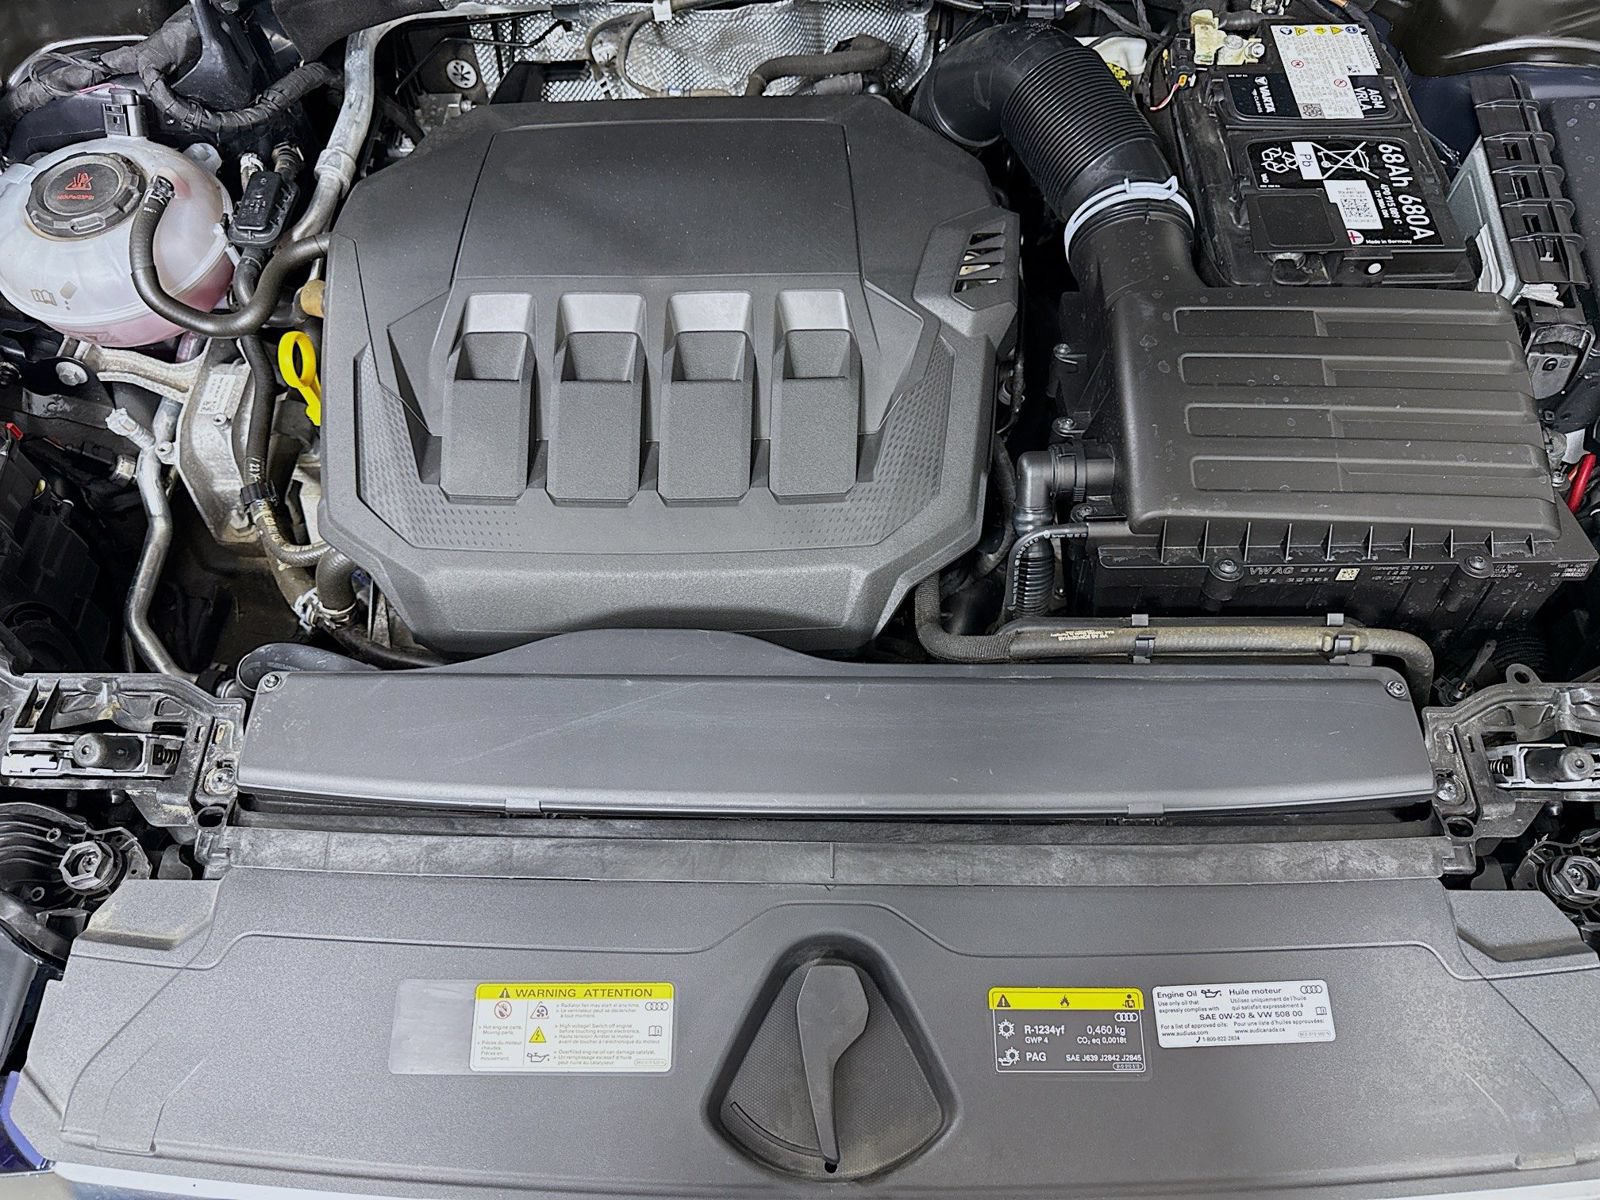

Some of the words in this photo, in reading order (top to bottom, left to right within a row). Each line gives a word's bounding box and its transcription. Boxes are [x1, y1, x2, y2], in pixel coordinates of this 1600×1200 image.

[1259, 86, 1276, 113] VARTA
[1354, 87, 1372, 110] VRLA
[1366, 88, 1386, 108] AGM
[1300, 154, 1313, 167] Pb
[1378, 144, 1413, 187] 68Ah
[1398, 194, 1435, 240] 680A
[1250, 567, 1271, 575] VW
[1272, 566, 1294, 575] AG
[516, 989, 576, 998] WARNING
[584, 988, 652, 997] ATTENTION
[1024, 1025, 1065, 1036] R-1234yf
[1115, 1025, 1126, 1036] kg
[1026, 1052, 1047, 1061] PAG
